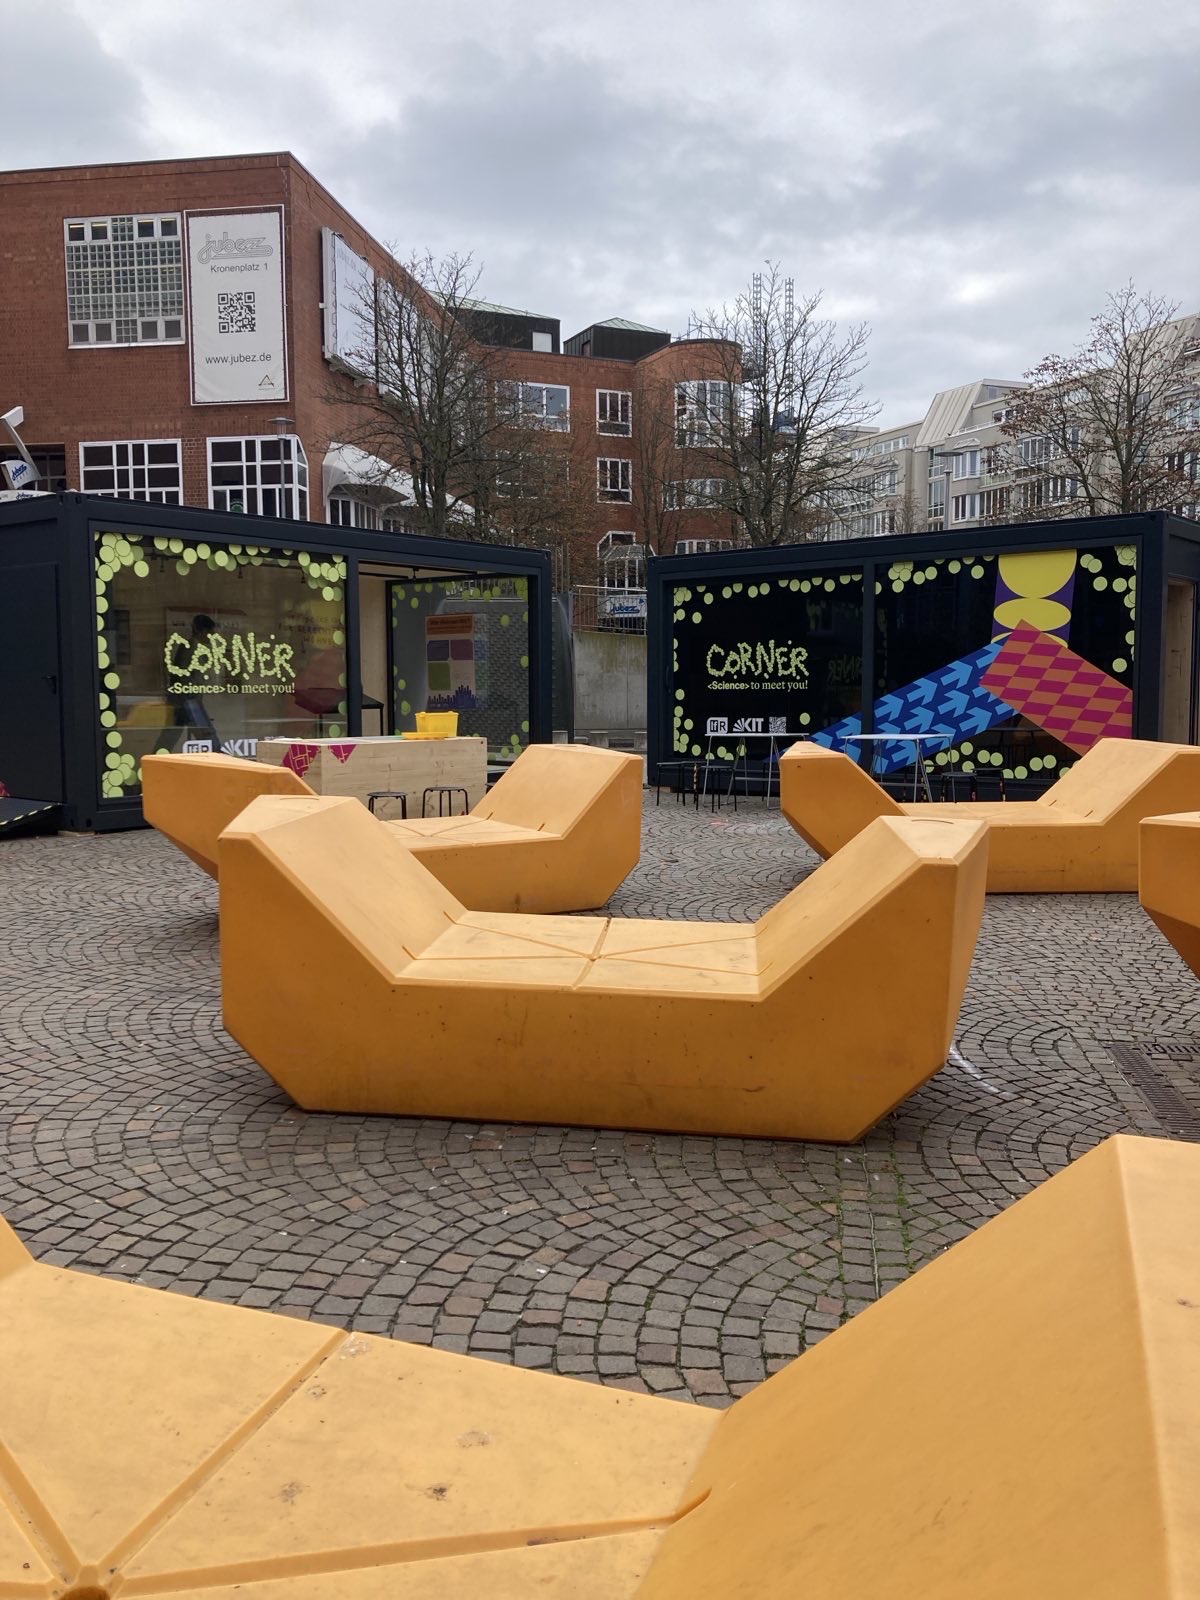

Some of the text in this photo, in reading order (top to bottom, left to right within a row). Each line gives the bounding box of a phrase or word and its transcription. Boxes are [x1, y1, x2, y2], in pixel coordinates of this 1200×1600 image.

[198, 231, 274, 265] jubez
[210, 262, 269, 273] Kronenplatz 1
[205, 352, 272, 366] www.jubez.de
[164, 632, 296, 682] CORNER
[706, 639, 810, 680] CORNER
[167, 682, 296, 697] <Science> to meet you!
[707, 680, 809, 693] <Science> to meet you!
[743, 717, 764, 732] KIT
[229, 738, 259, 756] KIT
